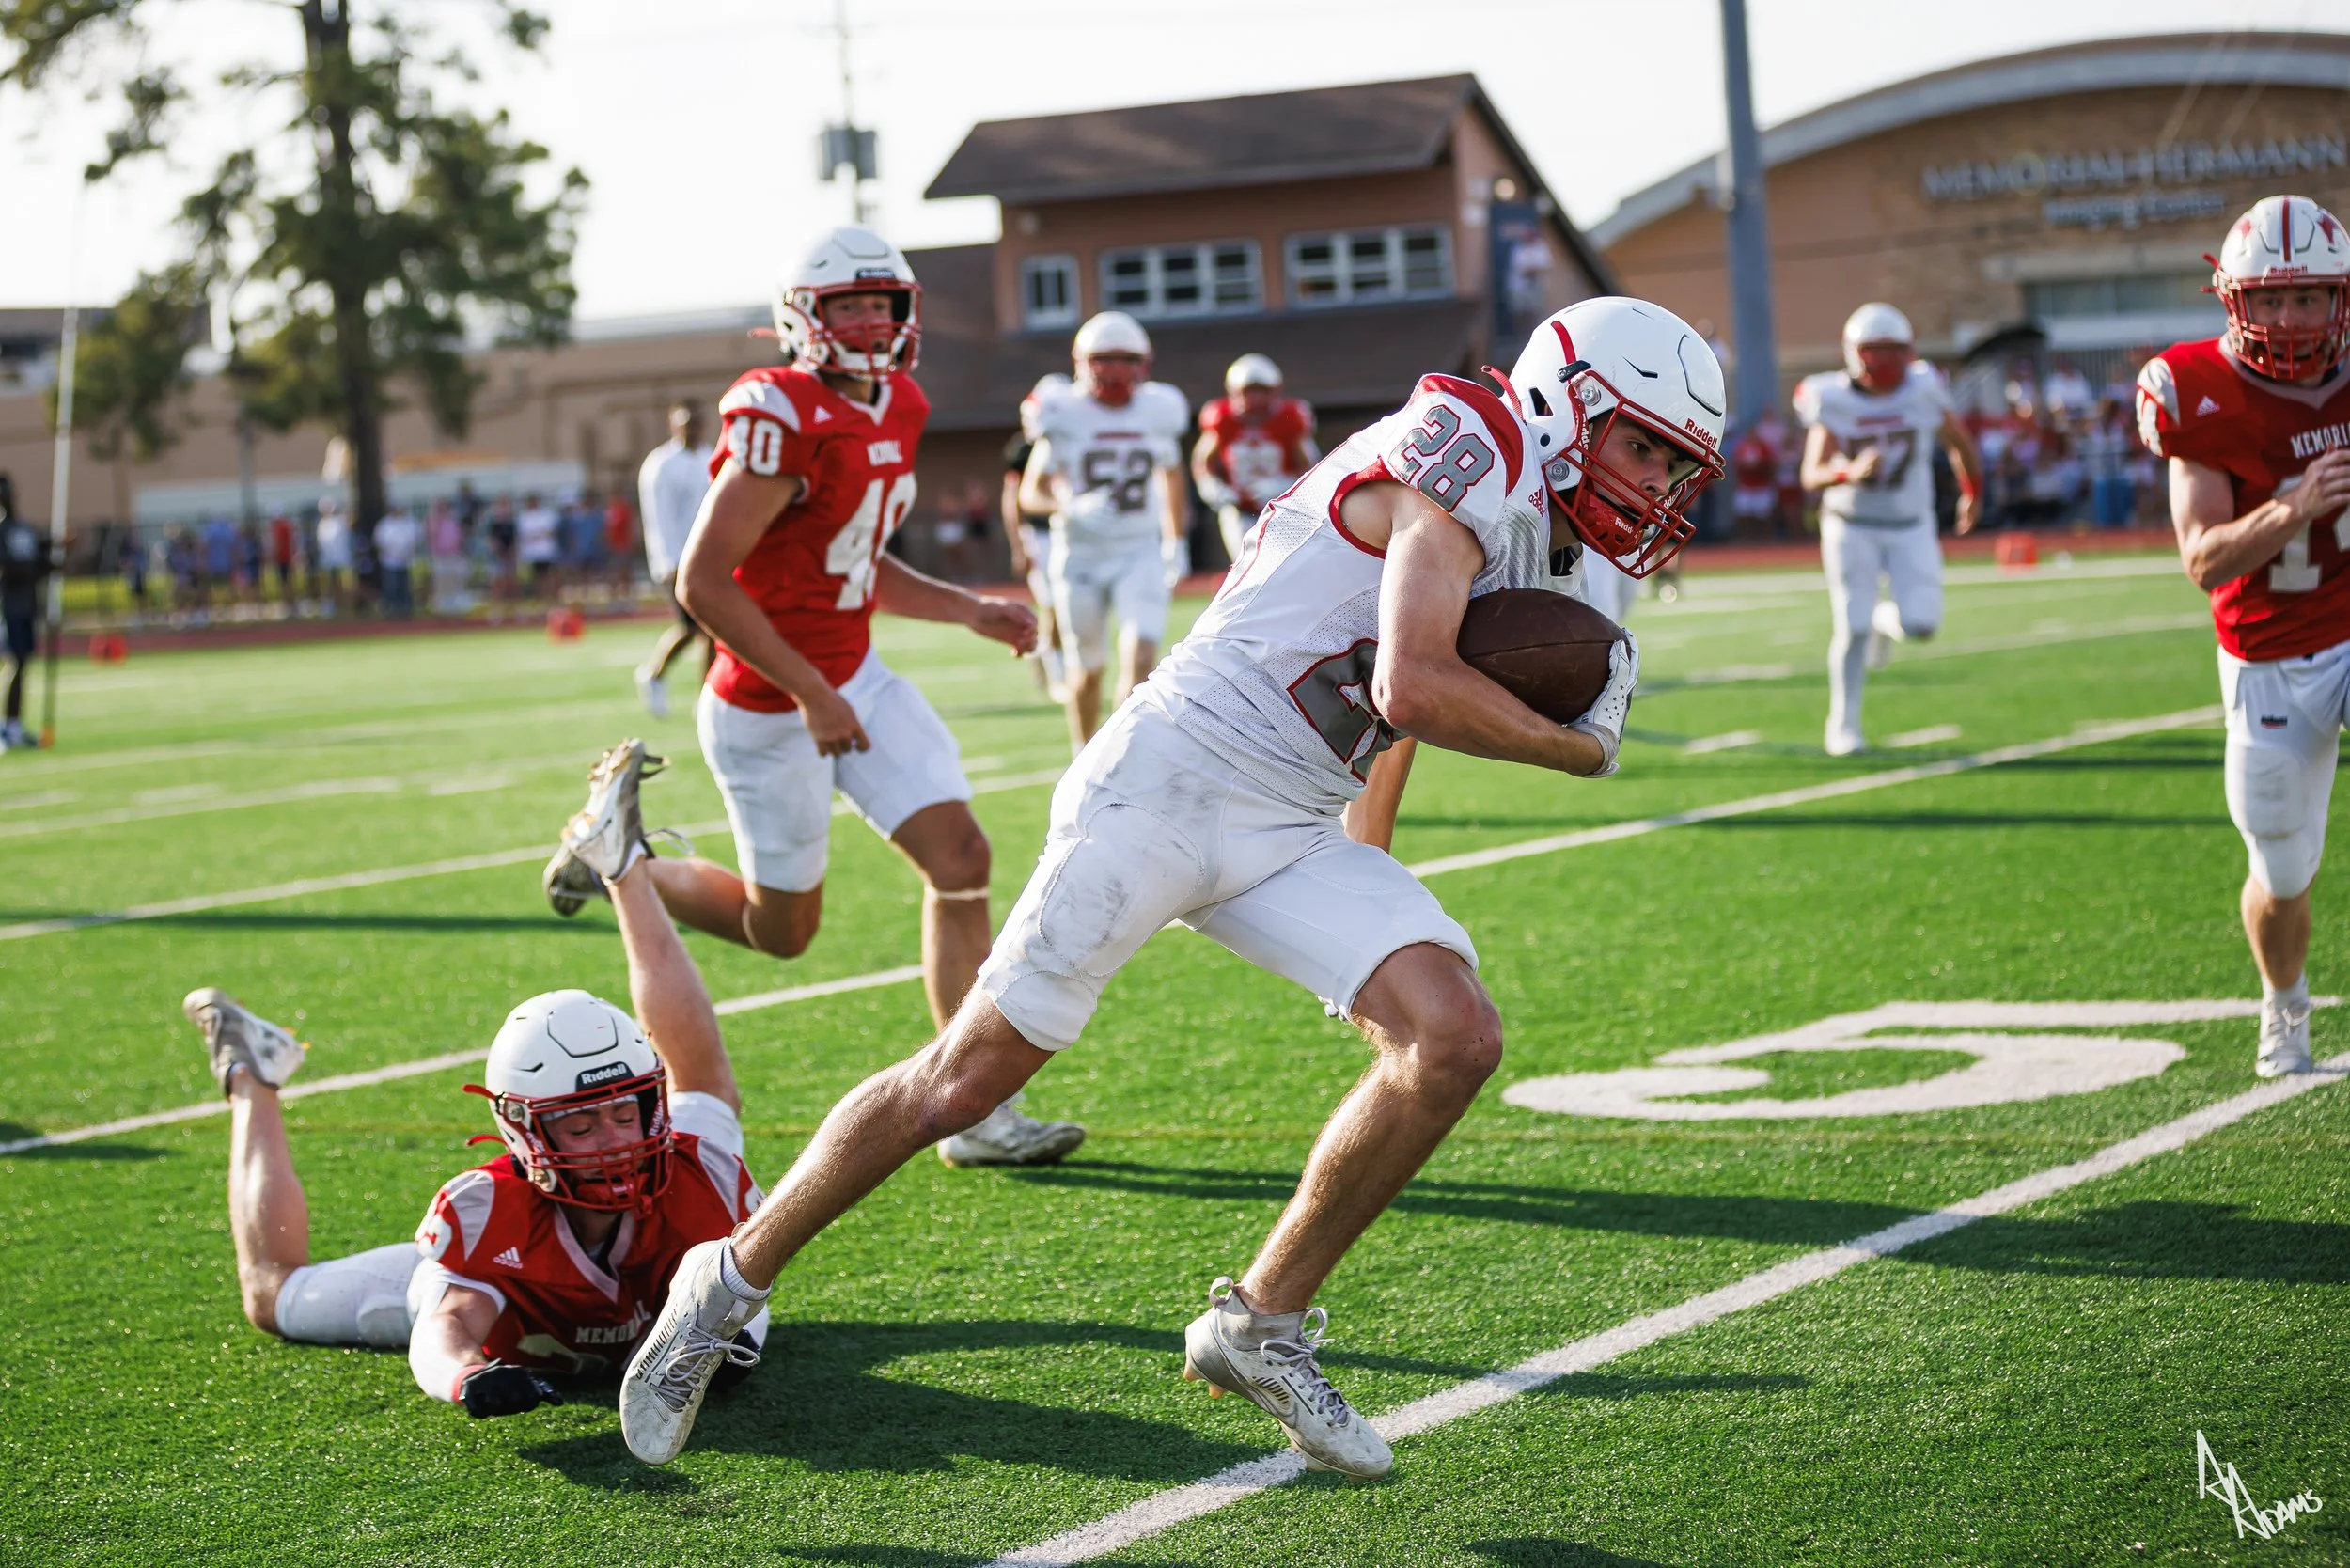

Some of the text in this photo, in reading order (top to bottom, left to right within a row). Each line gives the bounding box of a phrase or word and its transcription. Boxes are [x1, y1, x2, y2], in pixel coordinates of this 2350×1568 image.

[1684, 417, 1718, 448] Riddell
[2290, 420, 2350, 460] MEMORI
[1387, 401, 1497, 513] 28
[824, 471, 918, 611] 40
[580, 1062, 628, 1085] Riddell
